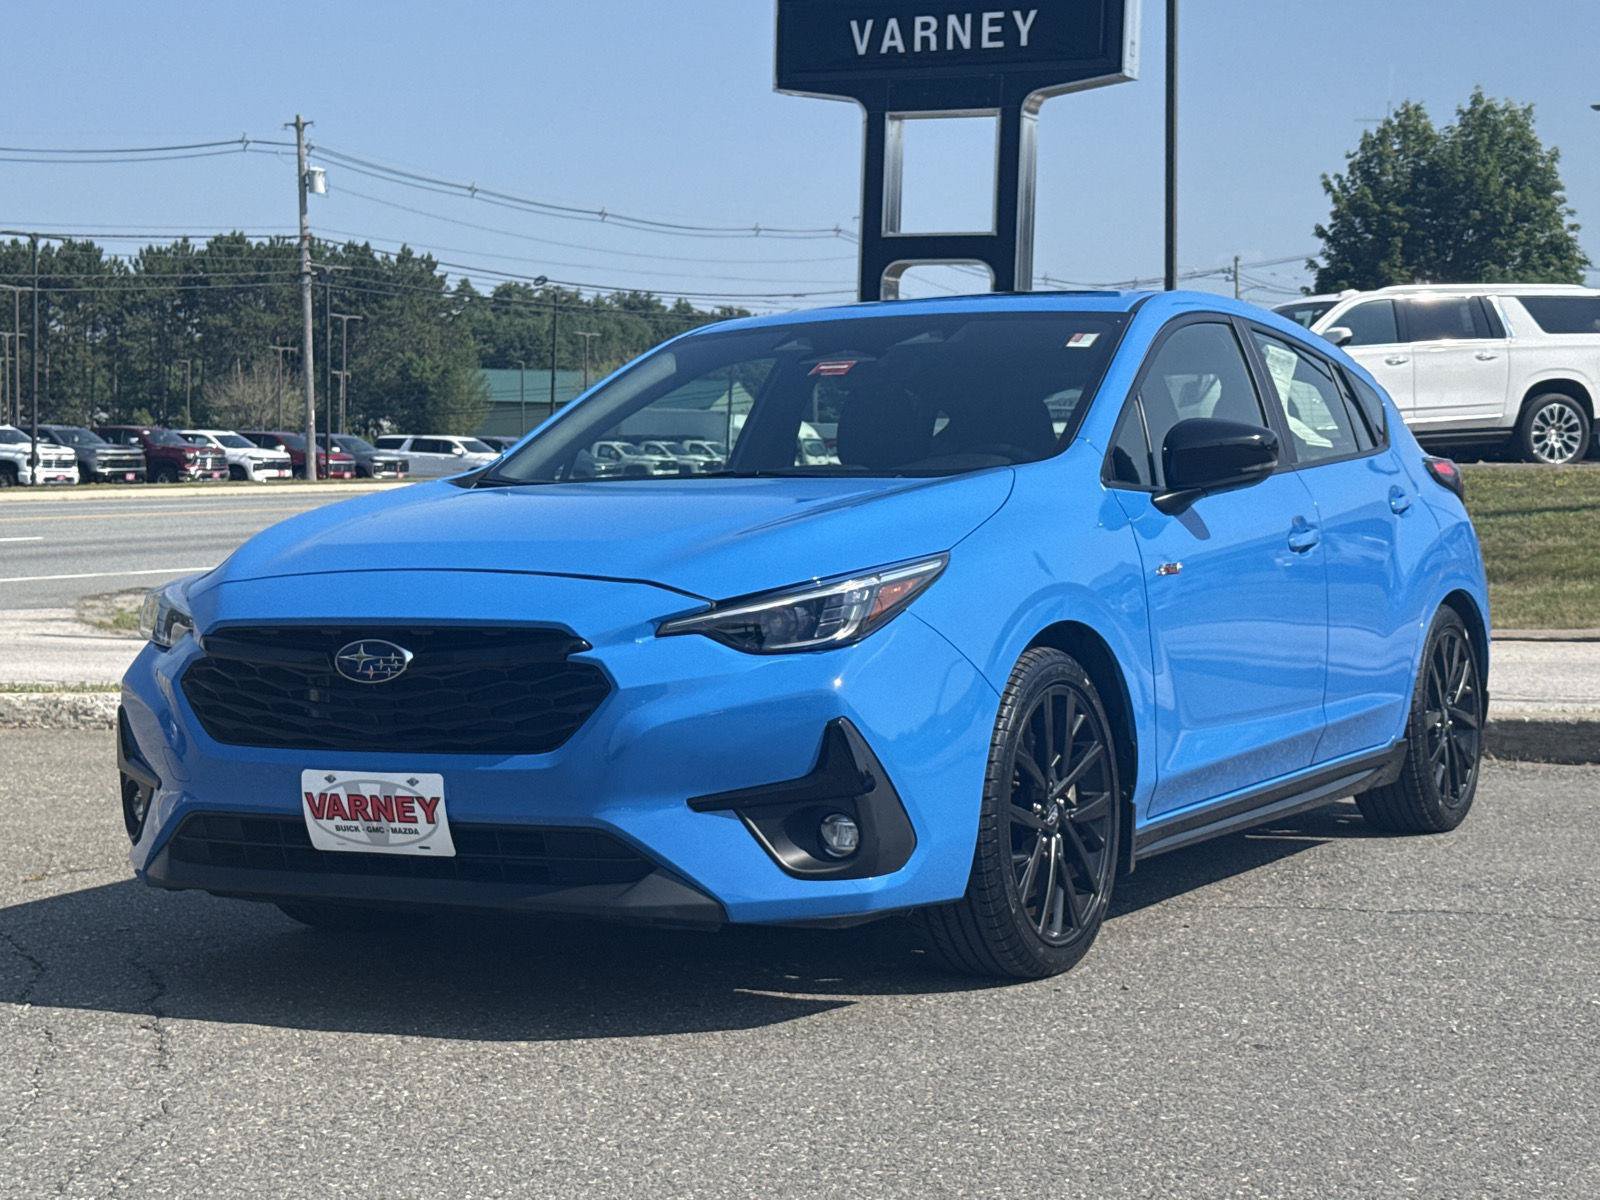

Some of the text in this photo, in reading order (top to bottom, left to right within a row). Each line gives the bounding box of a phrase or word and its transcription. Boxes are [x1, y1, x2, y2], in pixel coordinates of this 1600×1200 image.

[850, 9, 1038, 56] VARNEY
[304, 791, 441, 825] VARNEY
[335, 825, 420, 836] BUICK GMC MAZDA
